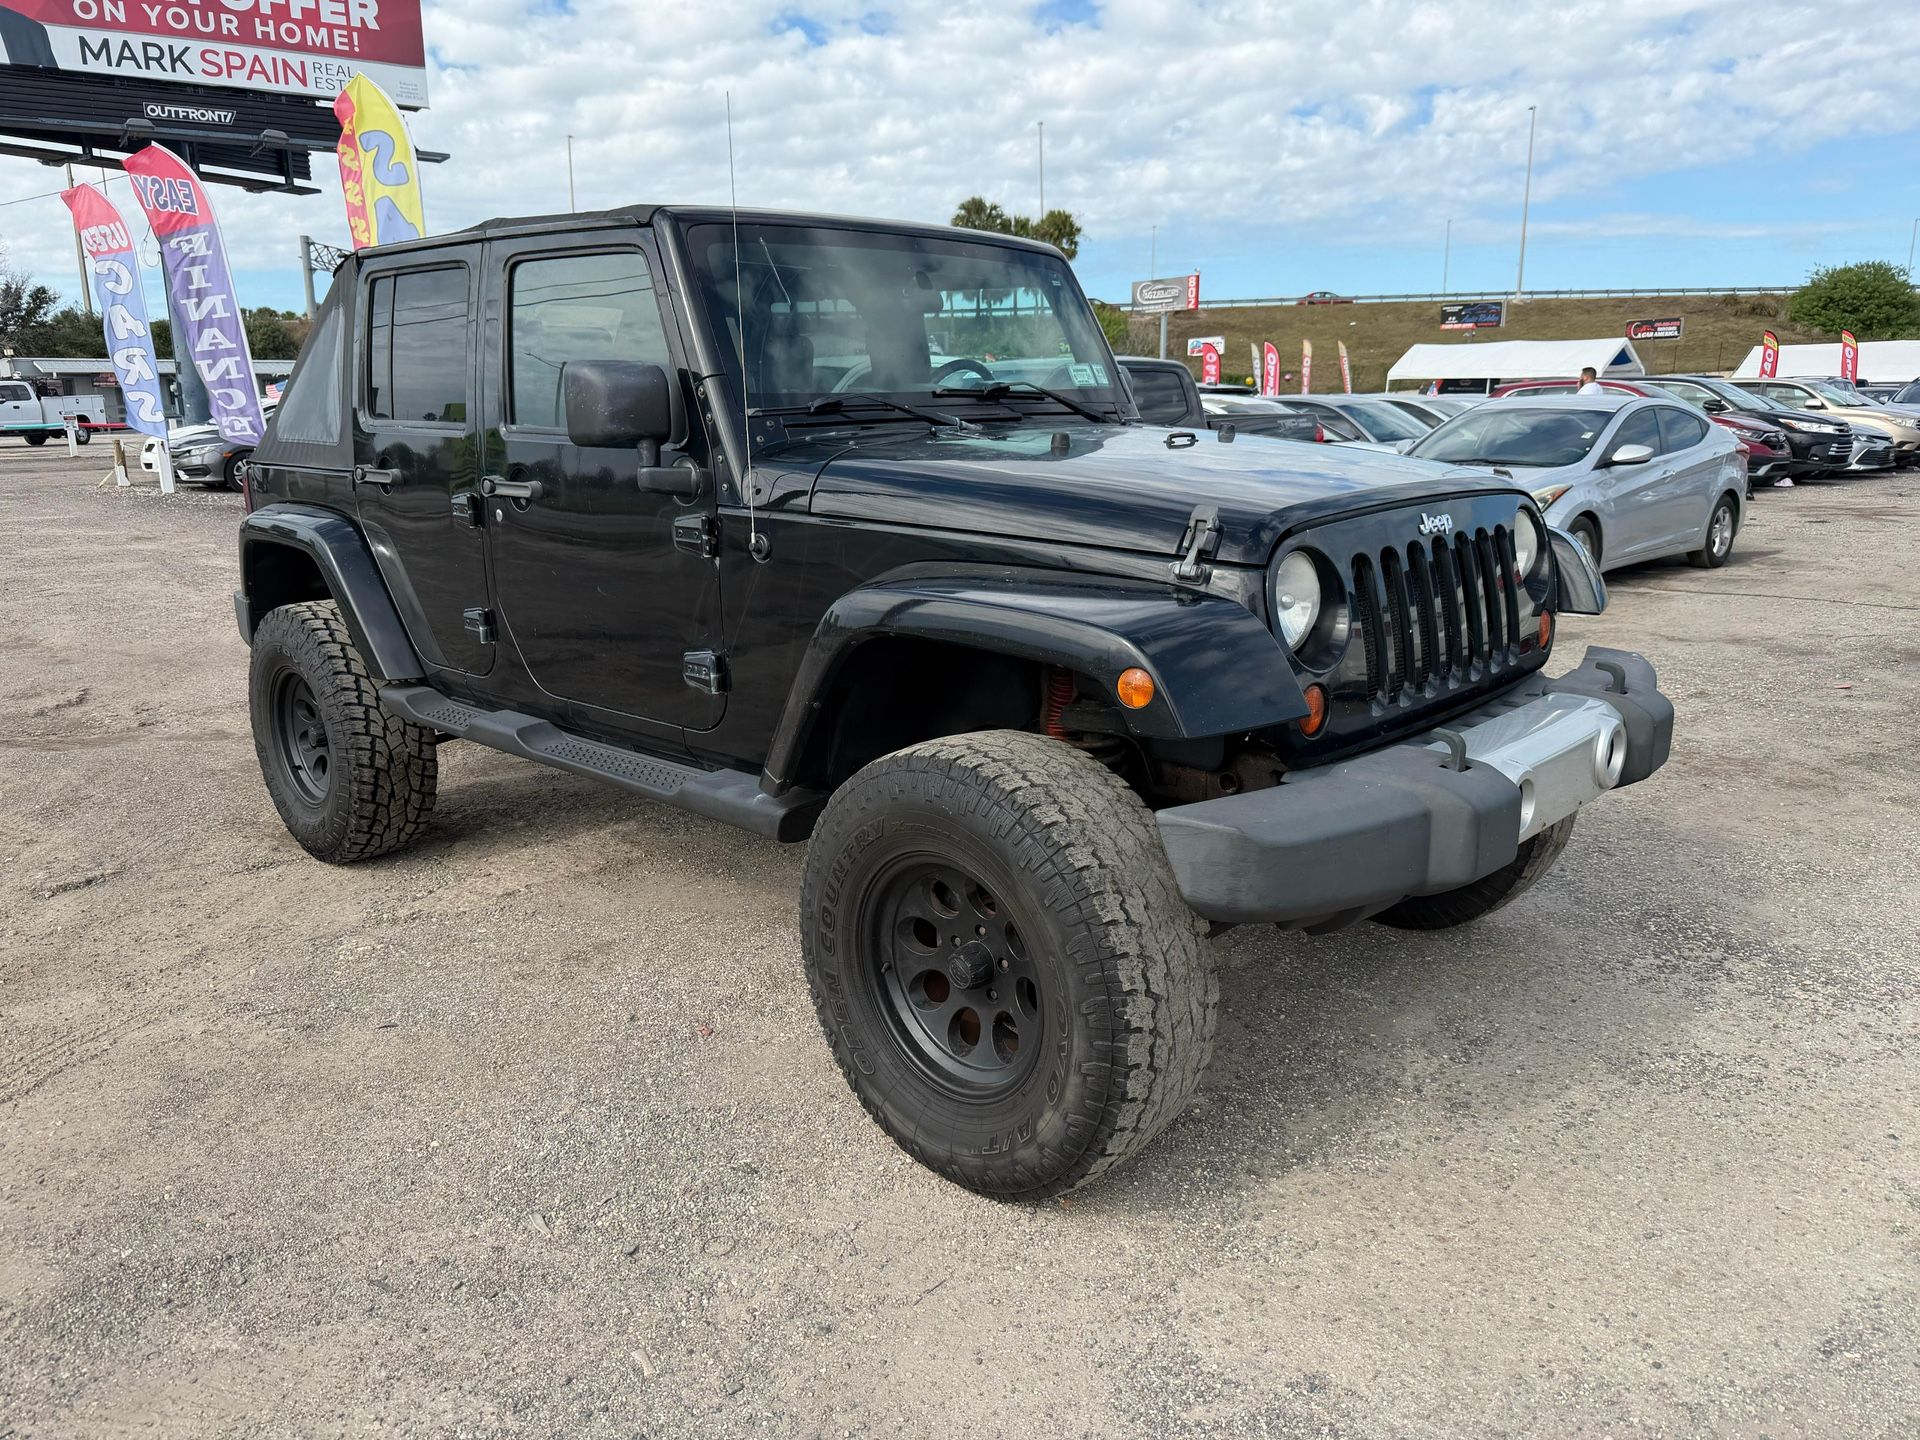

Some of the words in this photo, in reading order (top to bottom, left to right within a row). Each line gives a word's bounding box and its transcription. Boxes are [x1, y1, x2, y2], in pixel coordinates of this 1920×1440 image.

[73, 0, 126, 23] ON
[141, 3, 240, 37] YOUR
[254, 17, 360, 53] HOME!
[78, 35, 196, 75] MARK
[199, 48, 309, 88] SPAIN
[312, 61, 355, 79] REAL
[314, 76, 350, 92] EST
[1187, 276, 1197, 308] 802
[1418, 512, 1453, 536] Jeep
[819, 815, 885, 957] COUNTRY
[824, 968, 876, 1076] OPEN
[1046, 956, 1071, 1107] TOYO
